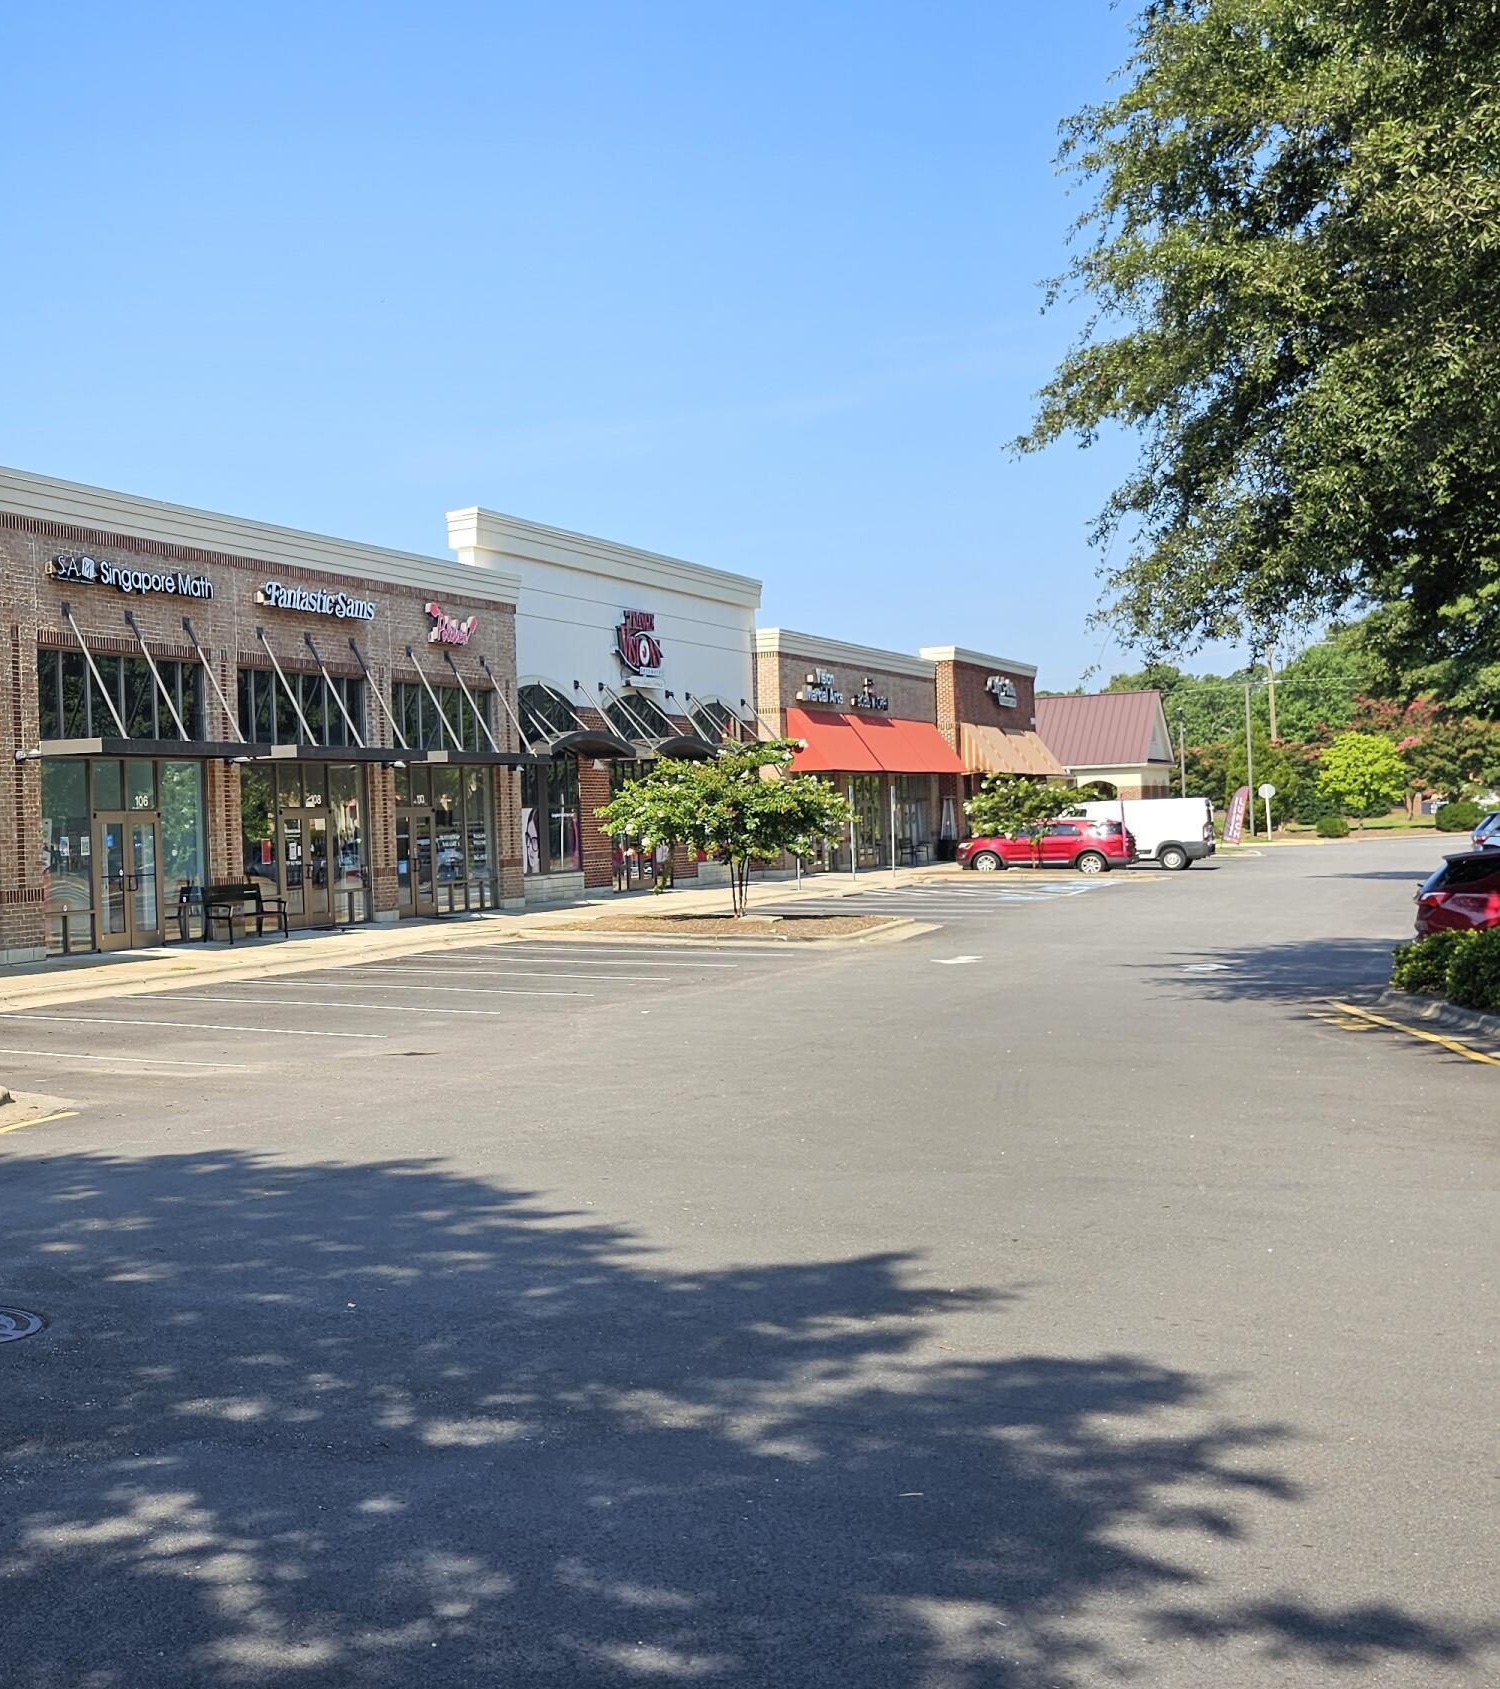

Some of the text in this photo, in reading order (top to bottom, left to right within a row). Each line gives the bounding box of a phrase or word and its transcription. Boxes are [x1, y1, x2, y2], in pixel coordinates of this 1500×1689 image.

[100, 560, 176, 594] Singapore
[177, 572, 214, 599] Math
[265, 581, 376, 620] Fantastic Sams
[829, 688, 844, 705] Arts
[134, 795, 149, 807] 106
